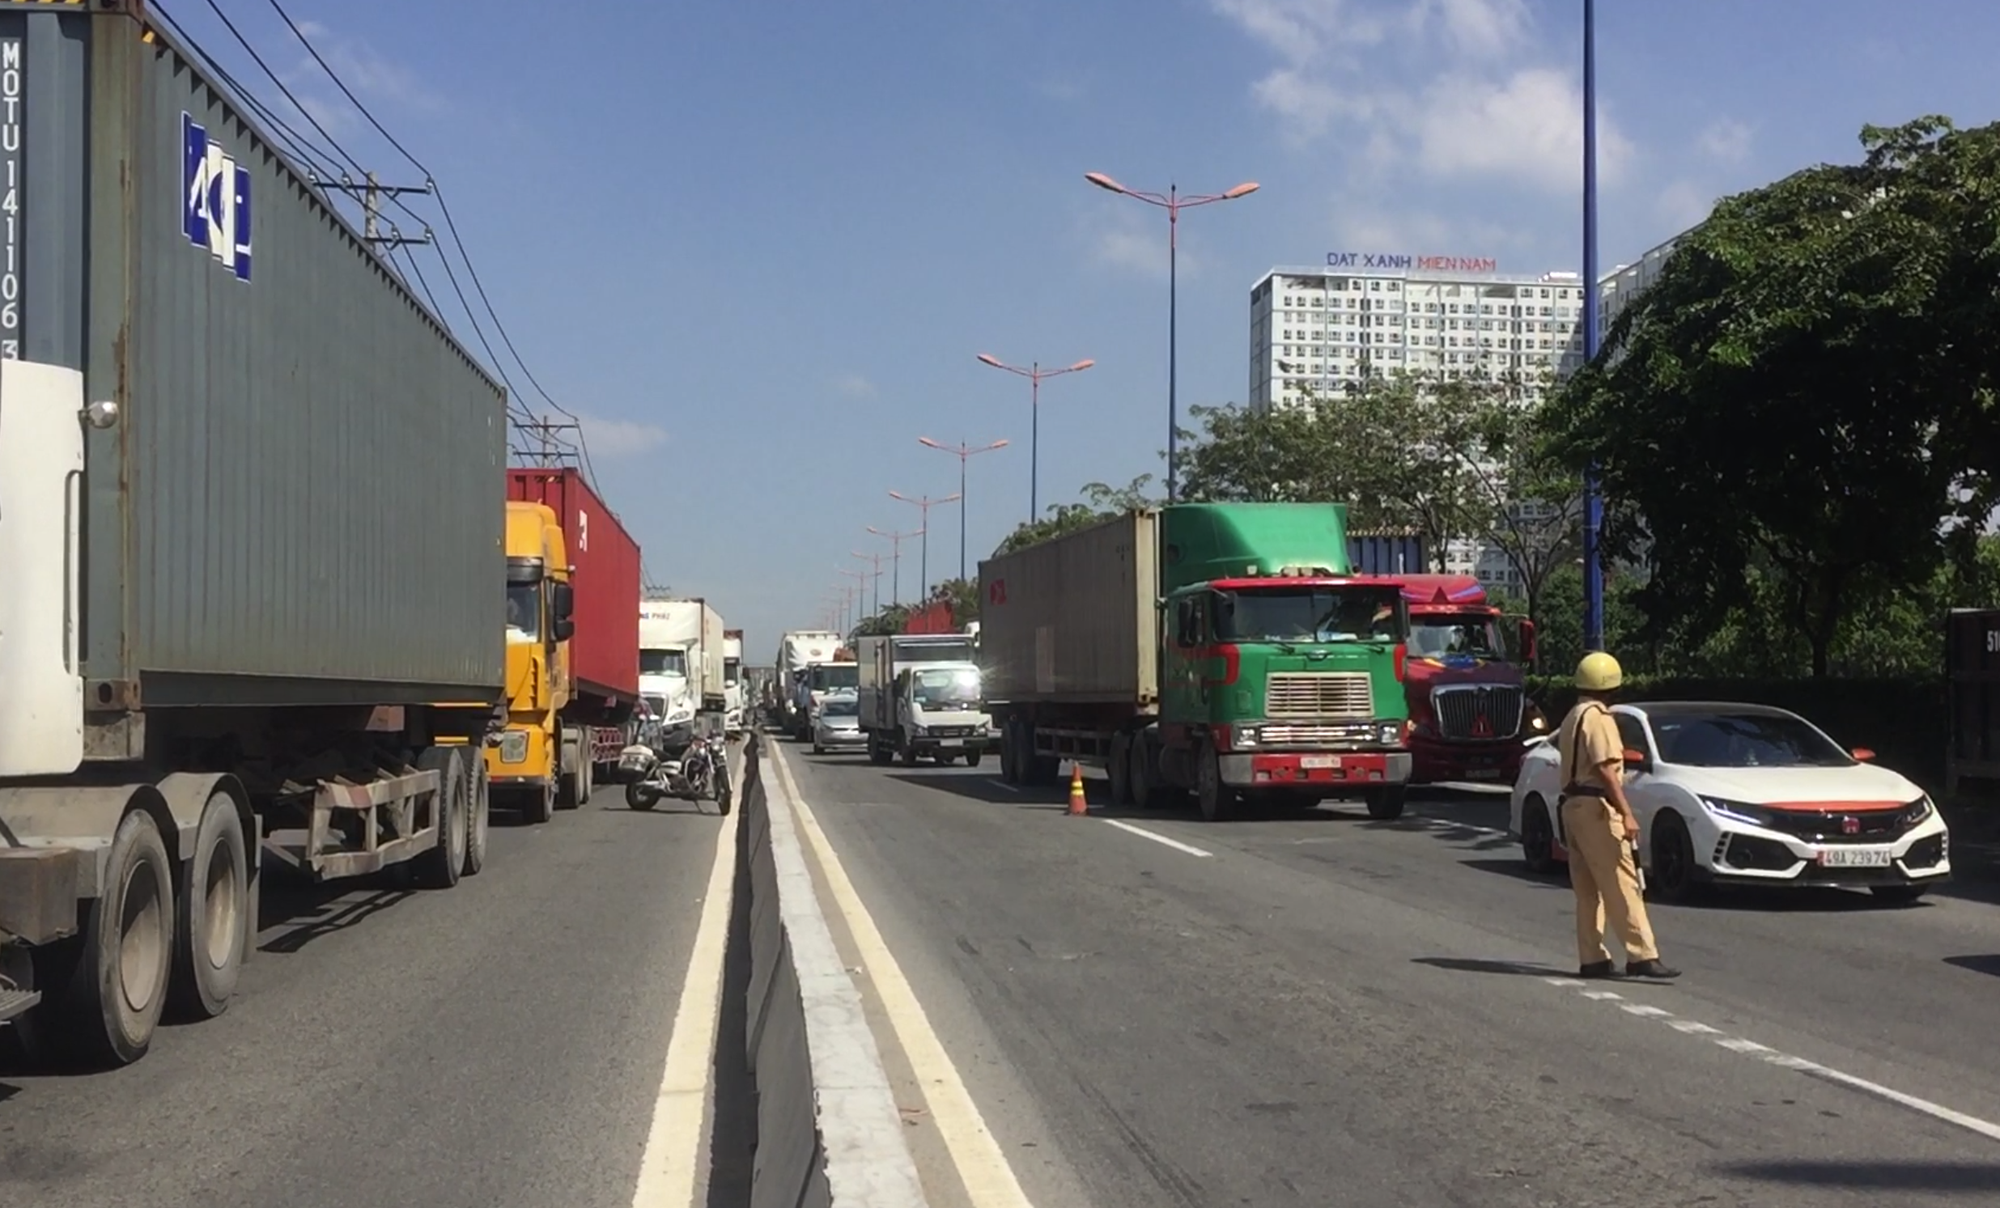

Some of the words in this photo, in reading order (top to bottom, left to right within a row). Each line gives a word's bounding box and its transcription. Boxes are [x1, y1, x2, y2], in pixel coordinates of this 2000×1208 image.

[3, 42, 19, 151] MOTU
[2, 160, 18, 329] 141106
[1364, 253, 1412, 268] XANH
[1460, 257, 1497, 272] NAM
